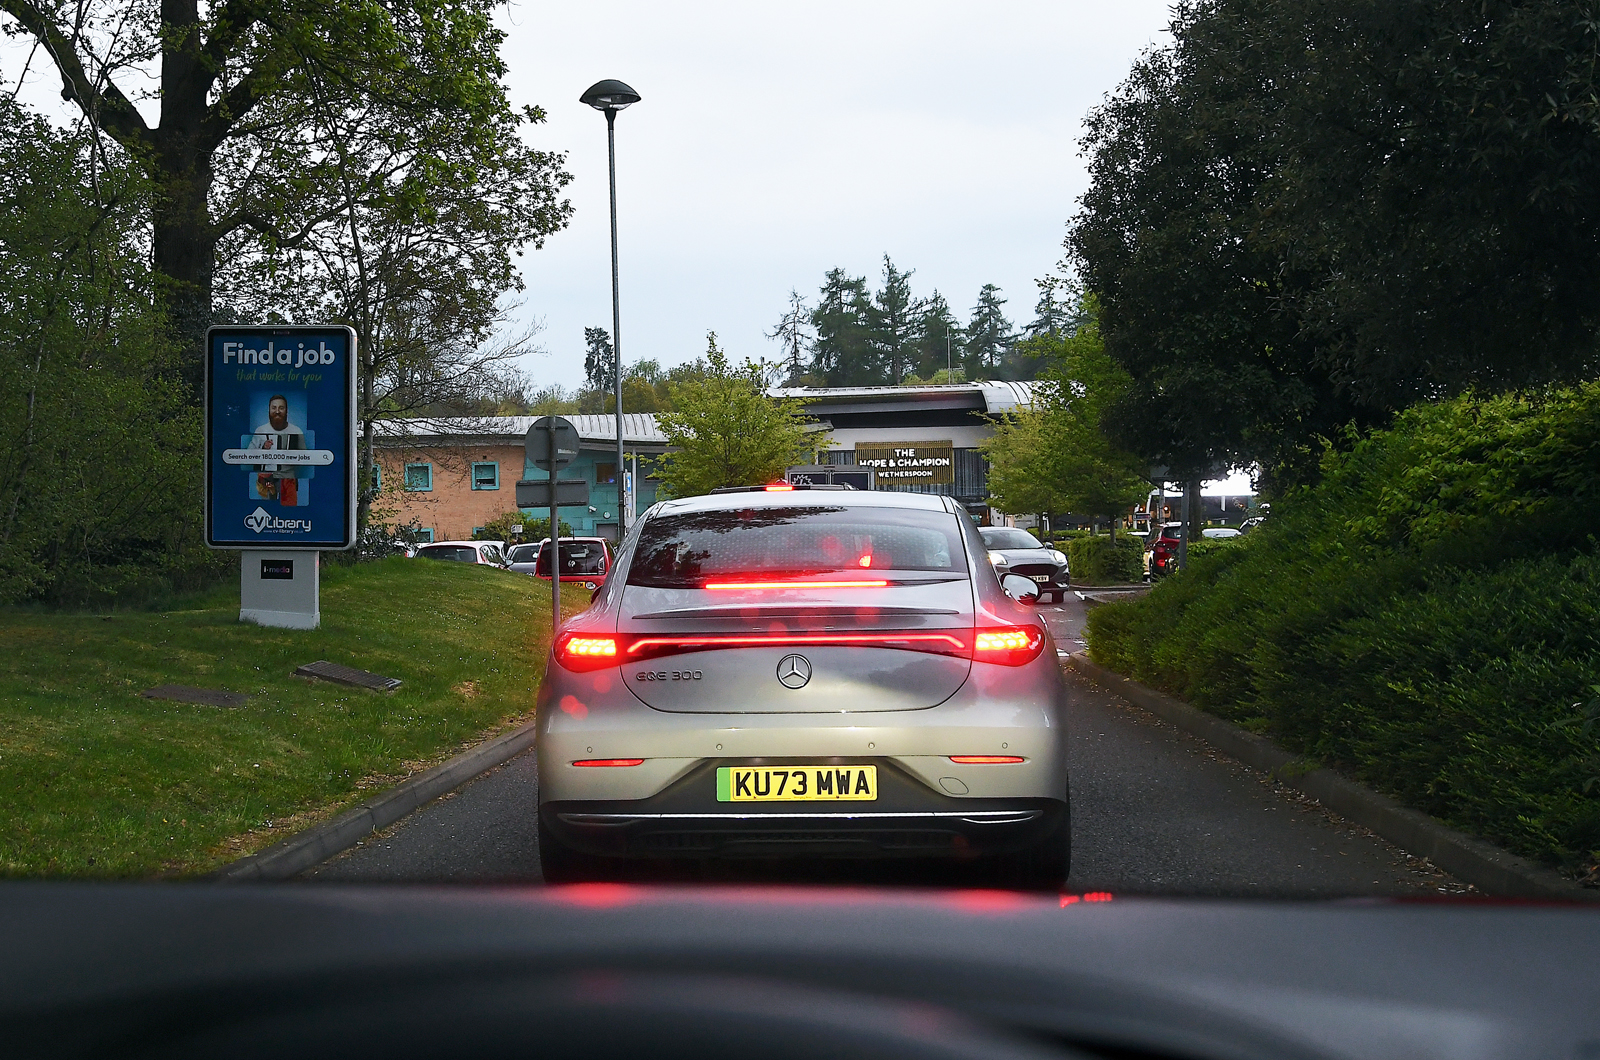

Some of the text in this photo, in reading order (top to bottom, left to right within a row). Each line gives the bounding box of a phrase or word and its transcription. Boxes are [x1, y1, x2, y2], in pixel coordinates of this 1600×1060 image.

[223, 341, 335, 368] Find a job
[236, 369, 322, 388] that works for you
[894, 448, 915, 457] THE
[859, 458, 950, 467] HOPE & CHAMPION
[878, 470, 933, 478] WETHERSPOON
[636, 669, 704, 681] EQE 300
[735, 770, 871, 796] KU73 MWA
